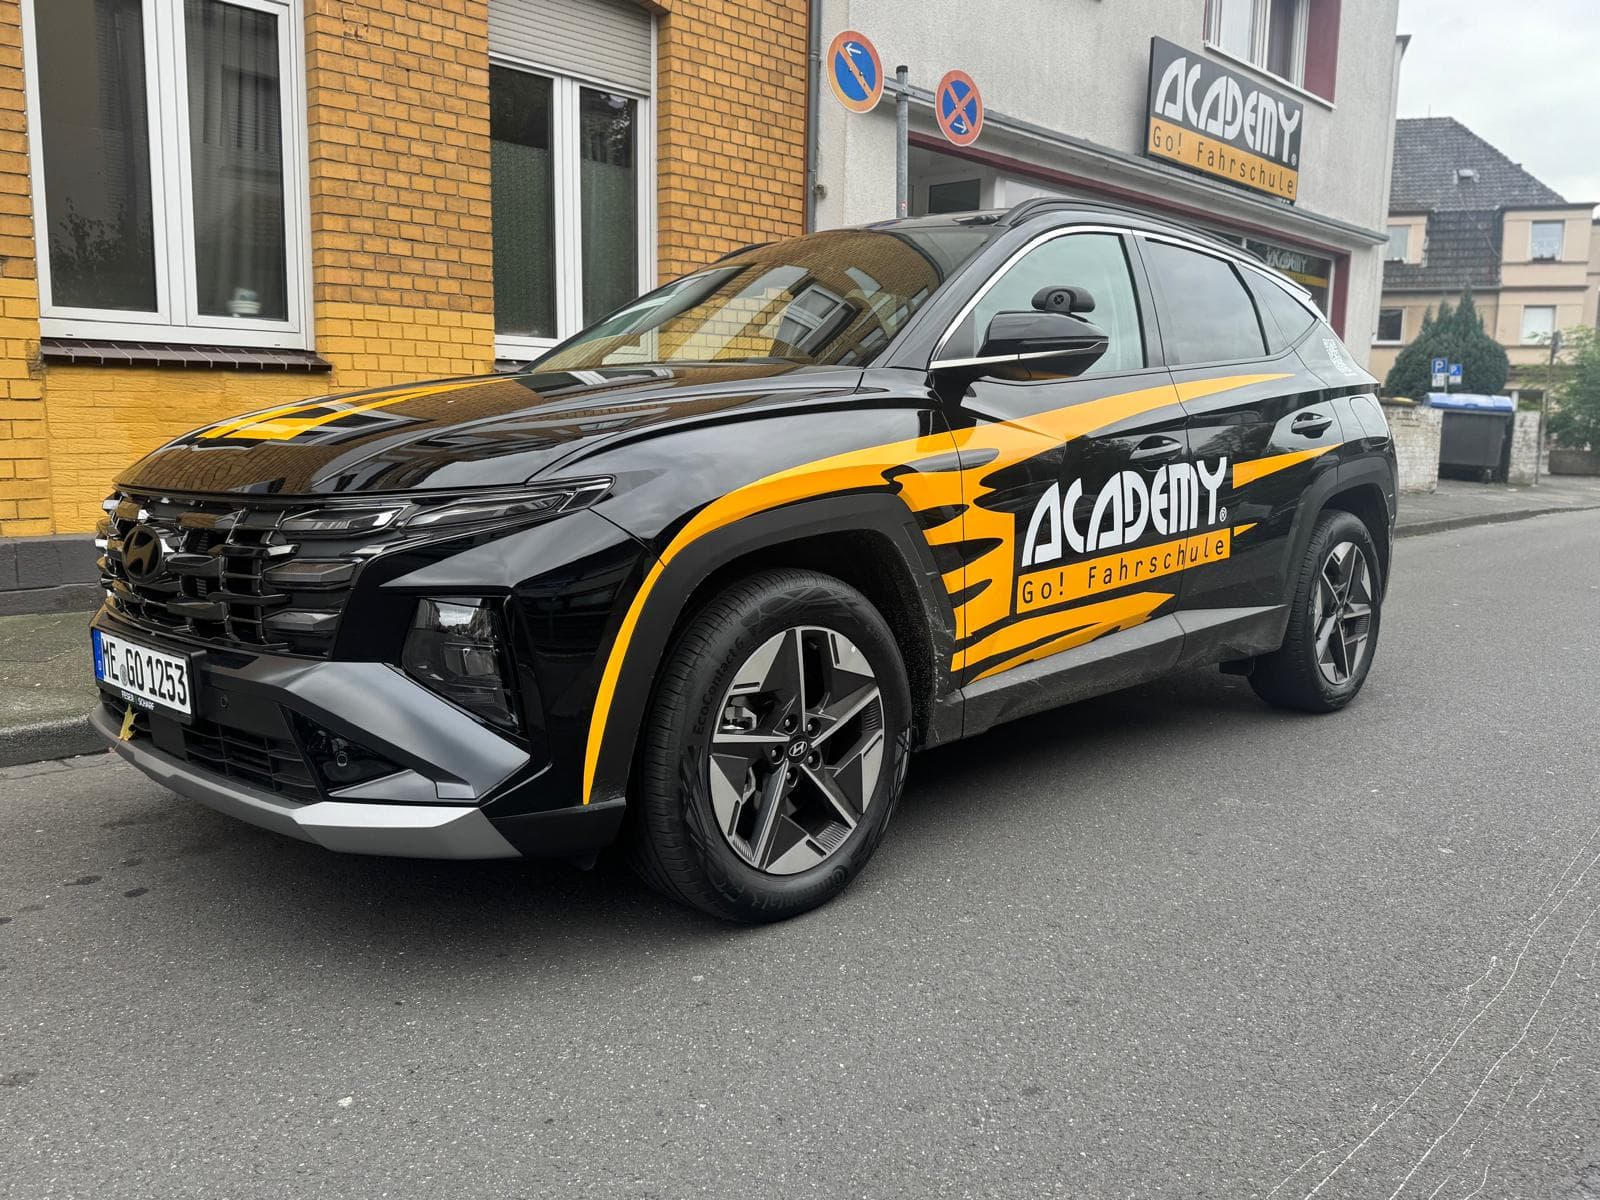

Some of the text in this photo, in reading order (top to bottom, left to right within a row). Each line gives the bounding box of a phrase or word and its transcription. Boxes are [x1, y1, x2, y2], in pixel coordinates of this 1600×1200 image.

[1153, 126, 1293, 194] Go! Fahrschule
[1435, 361, 1444, 373] P
[1022, 537, 1224, 604] Go! Fahrschule
[102, 638, 187, 706] ME GO 1253
[693, 648, 737, 735] EcoContact
